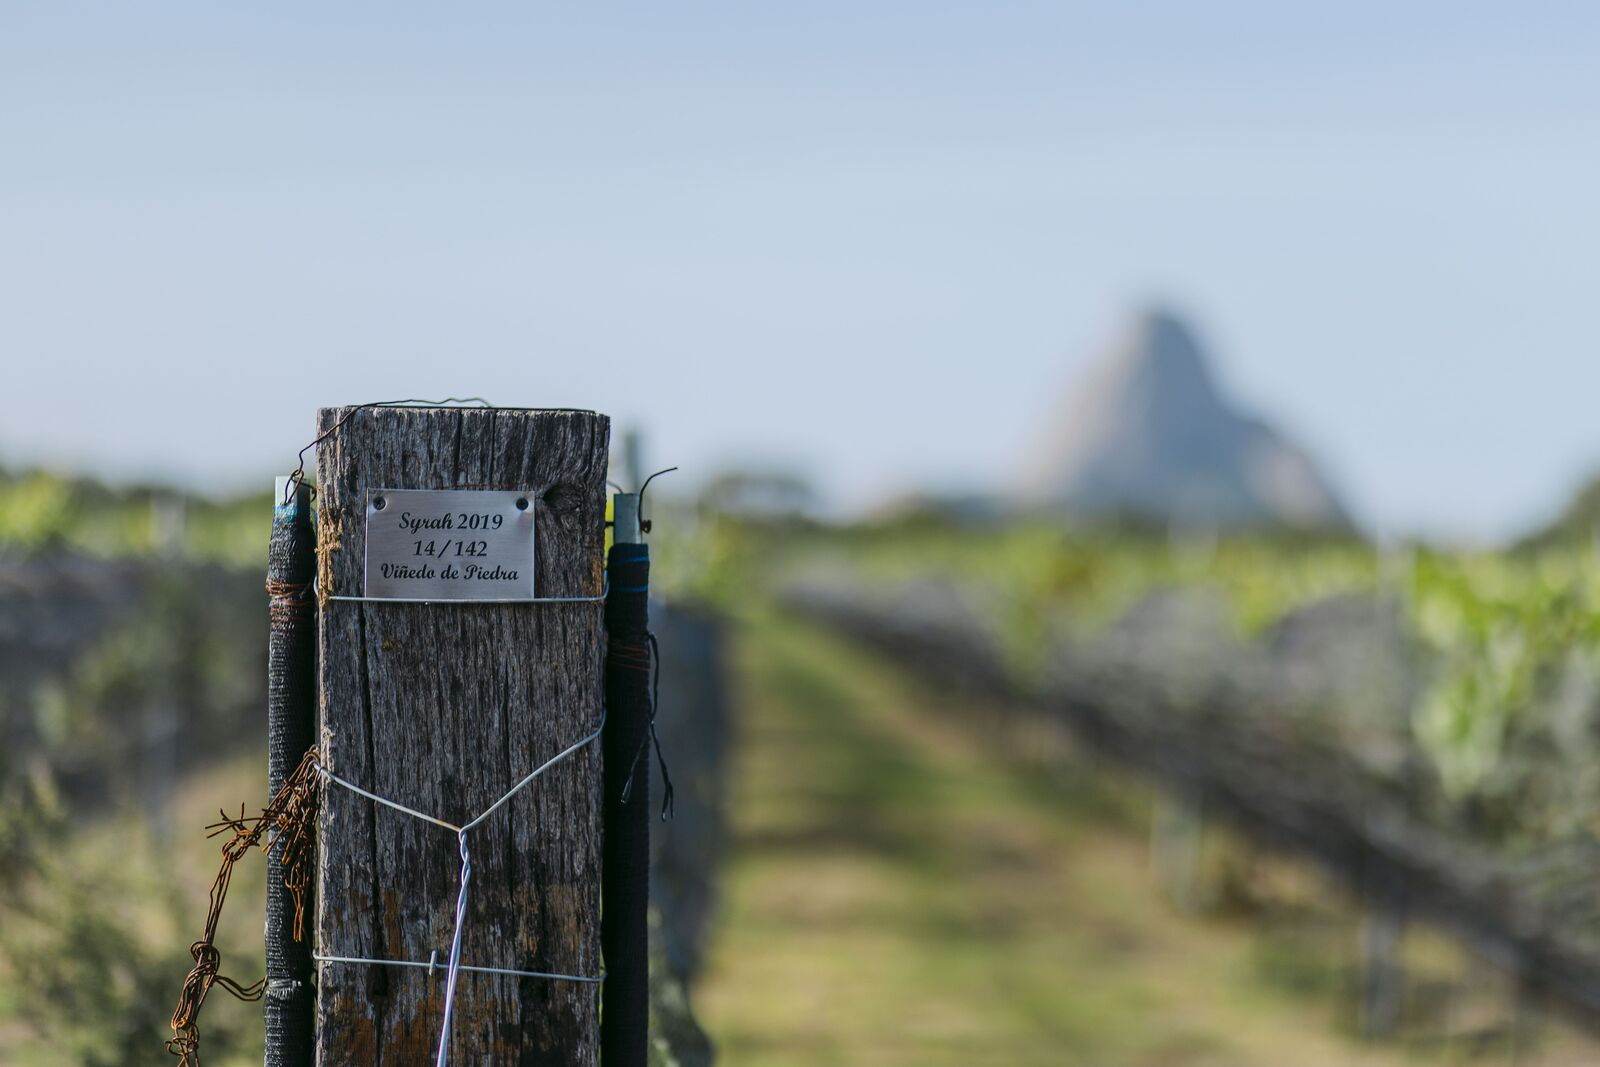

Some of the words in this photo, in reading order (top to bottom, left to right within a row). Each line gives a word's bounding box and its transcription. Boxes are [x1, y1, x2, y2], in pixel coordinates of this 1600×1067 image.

[399, 512, 453, 534] Syrah
[457, 513, 503, 530] 2019
[380, 563, 436, 579] Viñedo
[440, 564, 459, 580] de
[464, 564, 519, 580] Piedra
